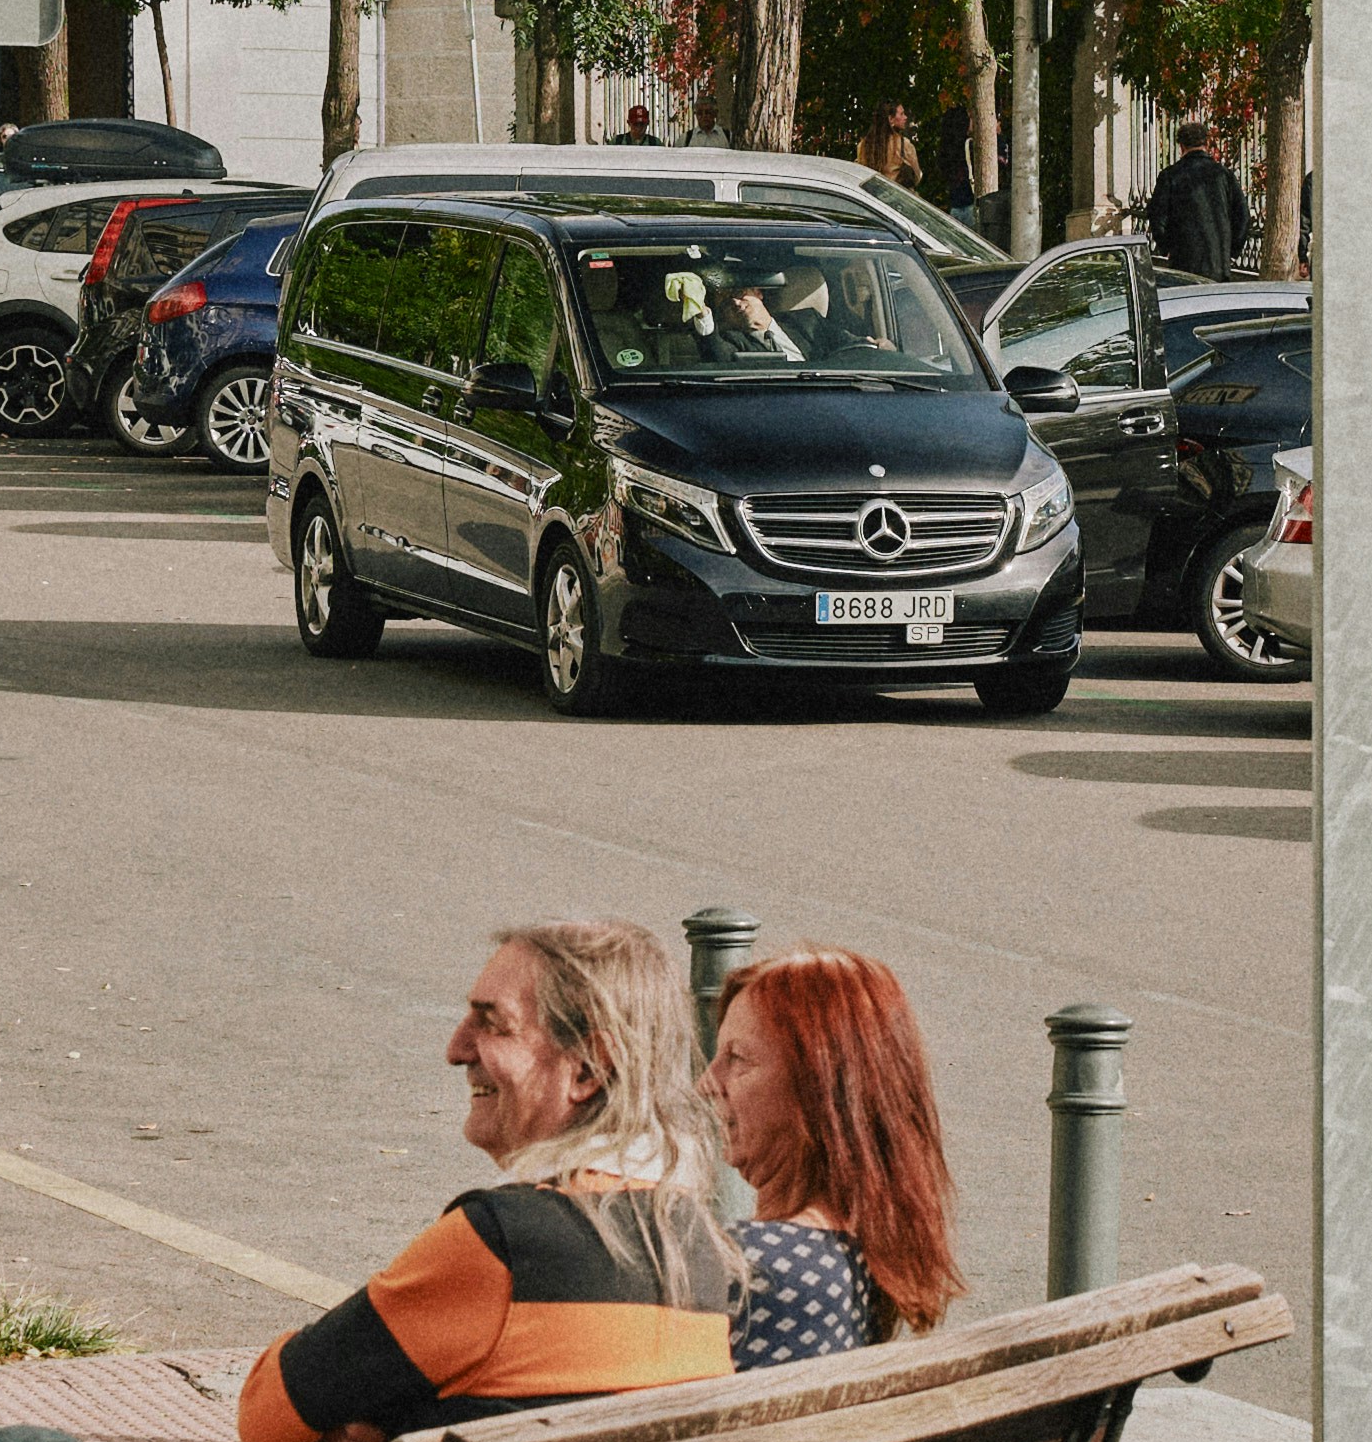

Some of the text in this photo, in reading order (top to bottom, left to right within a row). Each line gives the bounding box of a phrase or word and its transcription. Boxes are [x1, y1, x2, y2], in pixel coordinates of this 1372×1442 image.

[832, 596, 946, 619] 8688 JRD
[911, 626, 940, 641] SP
